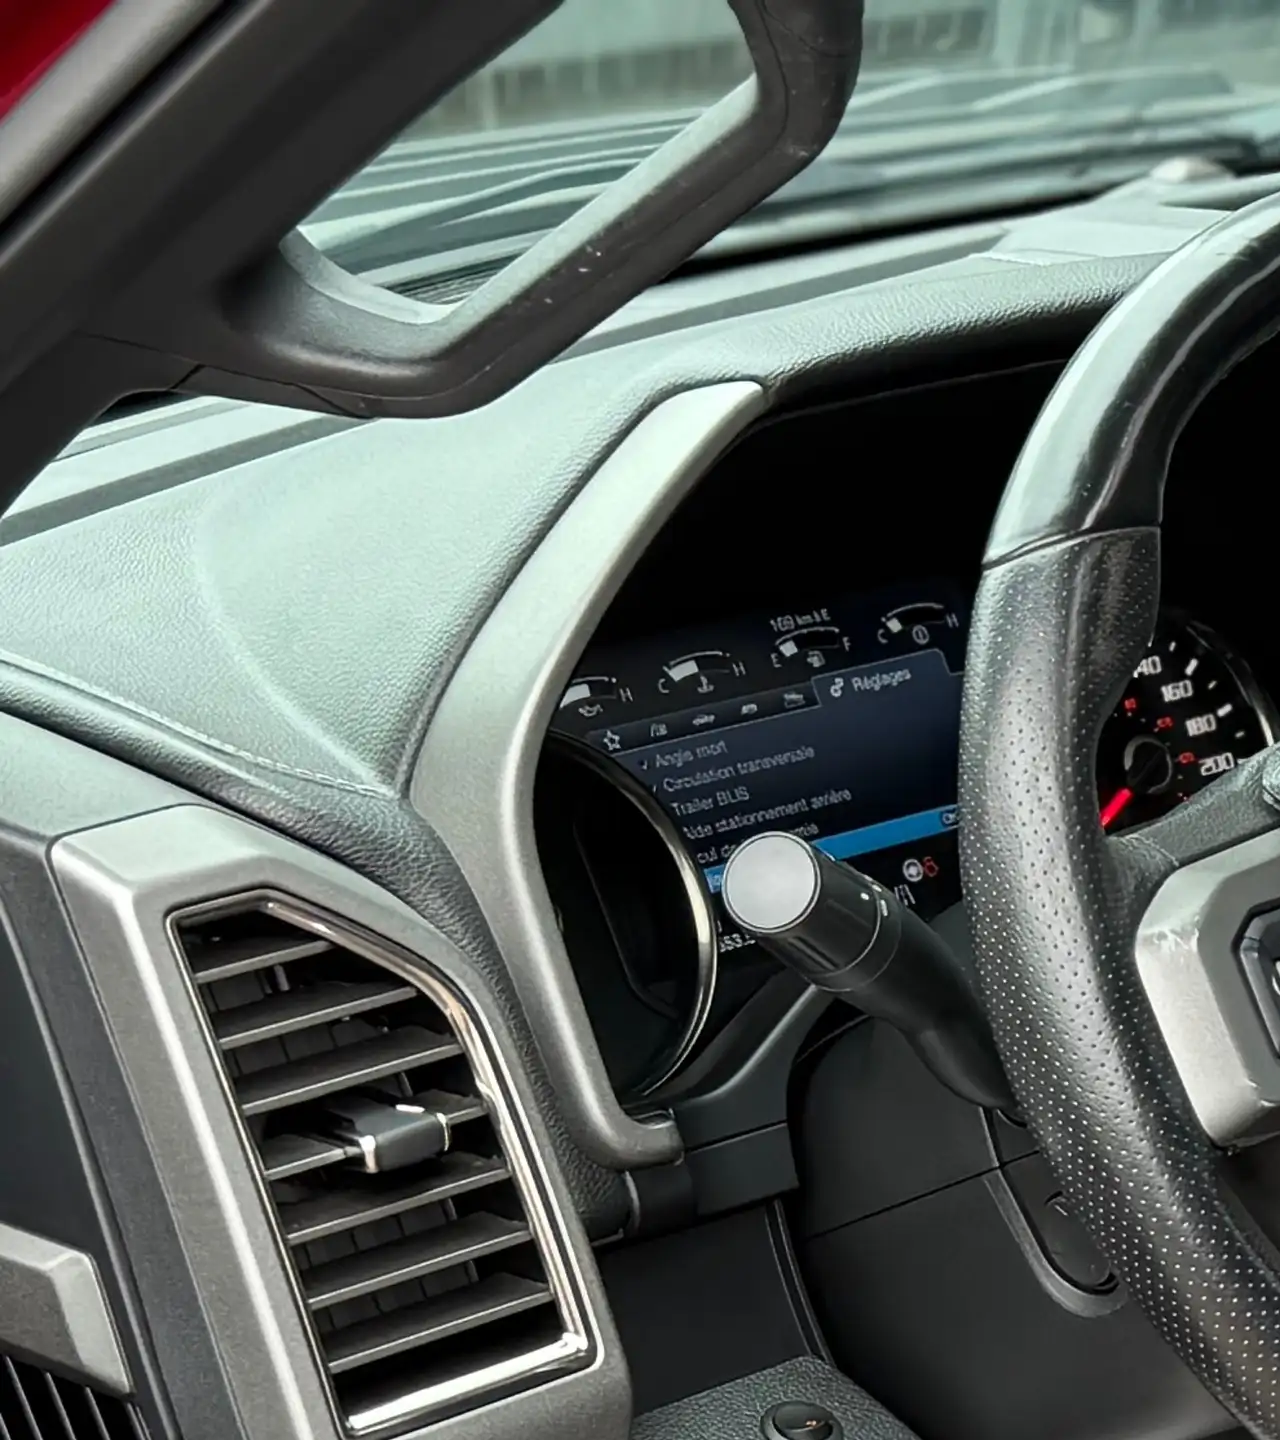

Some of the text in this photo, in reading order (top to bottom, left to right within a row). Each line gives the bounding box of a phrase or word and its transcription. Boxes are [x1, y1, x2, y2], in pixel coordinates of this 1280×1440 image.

[842, 637, 851, 652] F
[877, 629, 888, 644] C
[732, 662, 746, 677] H
[770, 653, 782, 669] E
[658, 678, 670, 694] C
[851, 668, 912, 692] Réglages
[1160, 679, 1194, 702] 160
[619, 687, 633, 702] H
[1185, 713, 1217, 737] 180
[655, 739, 728, 769] Angle mort
[1198, 752, 1235, 776] 200
[662, 745, 815, 793] Circulation transversale
[670, 785, 750, 817] Trailer BLIS
[715, 798, 809, 832] stationnement
[809, 787, 853, 810] arrière
